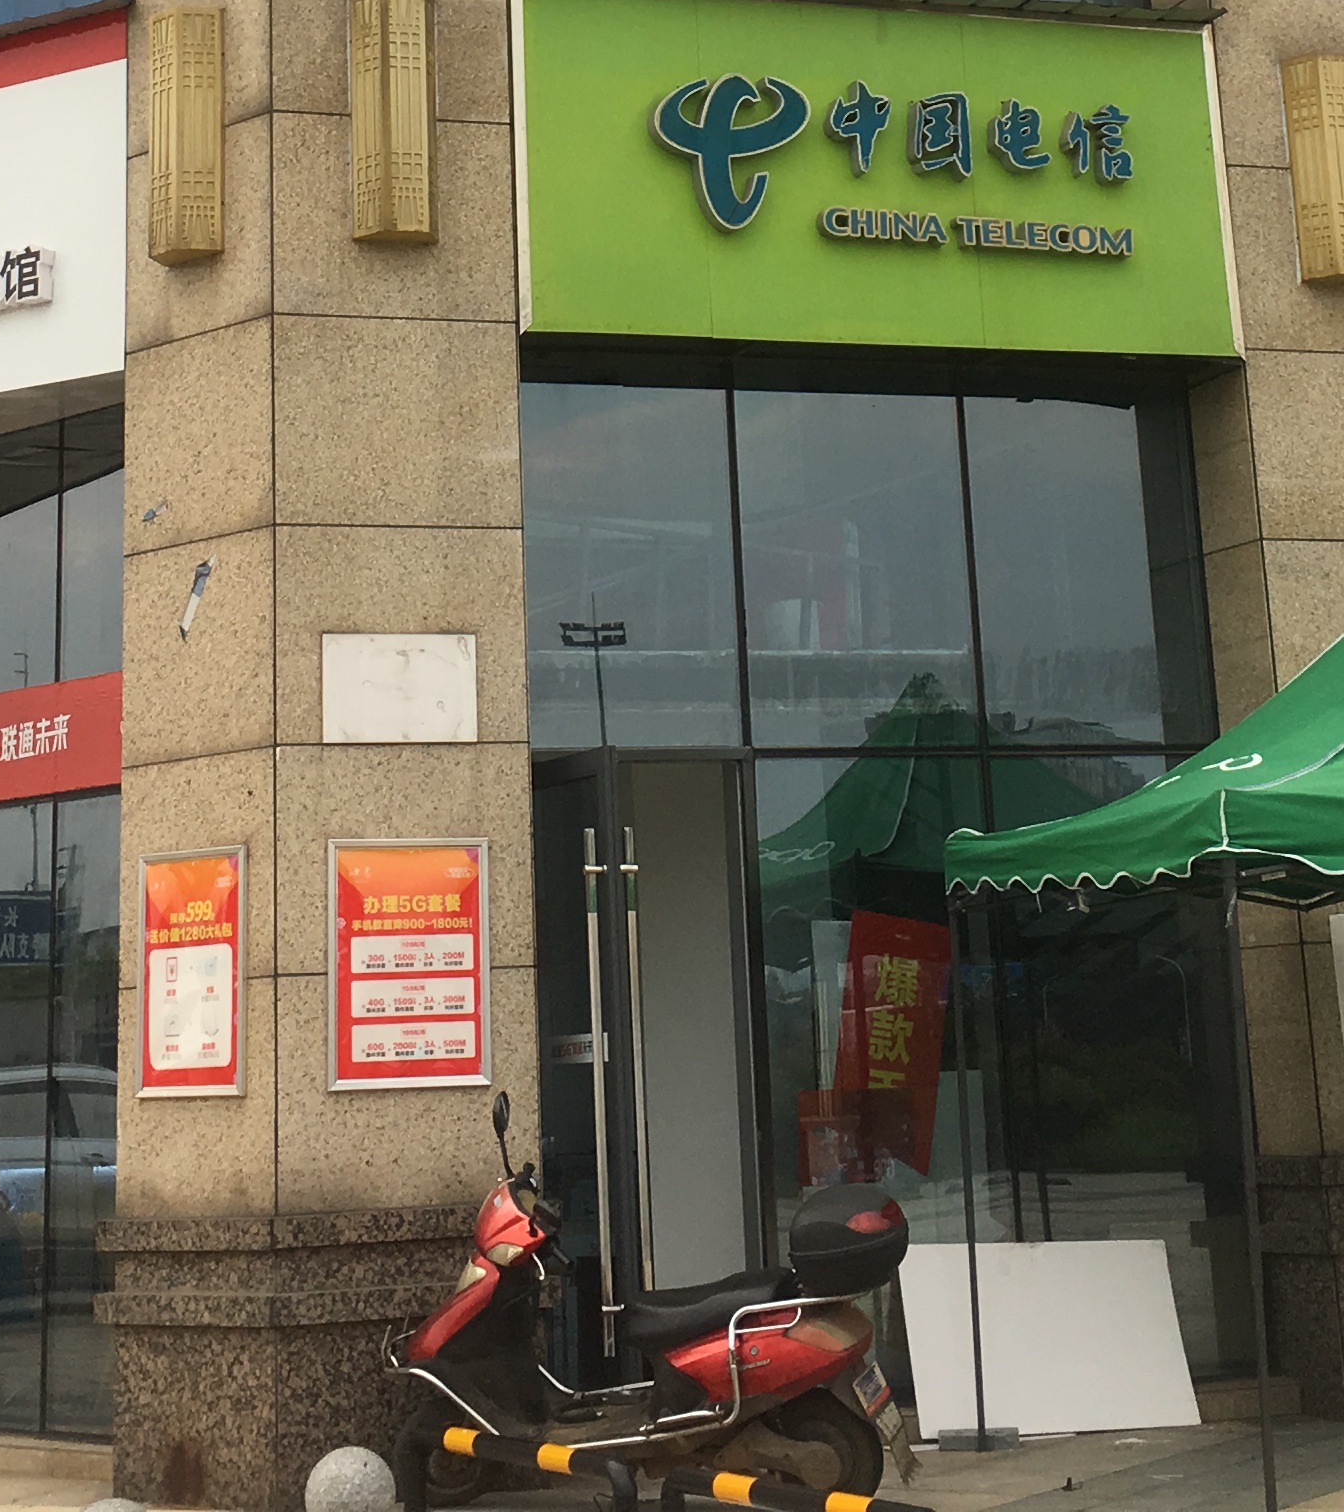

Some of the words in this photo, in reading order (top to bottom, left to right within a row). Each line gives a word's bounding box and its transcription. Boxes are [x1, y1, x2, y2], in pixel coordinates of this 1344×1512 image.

[826, 78, 1135, 182] 中国电信
[820, 205, 947, 246] CHINA
[954, 215, 1134, 257] TELECOM
